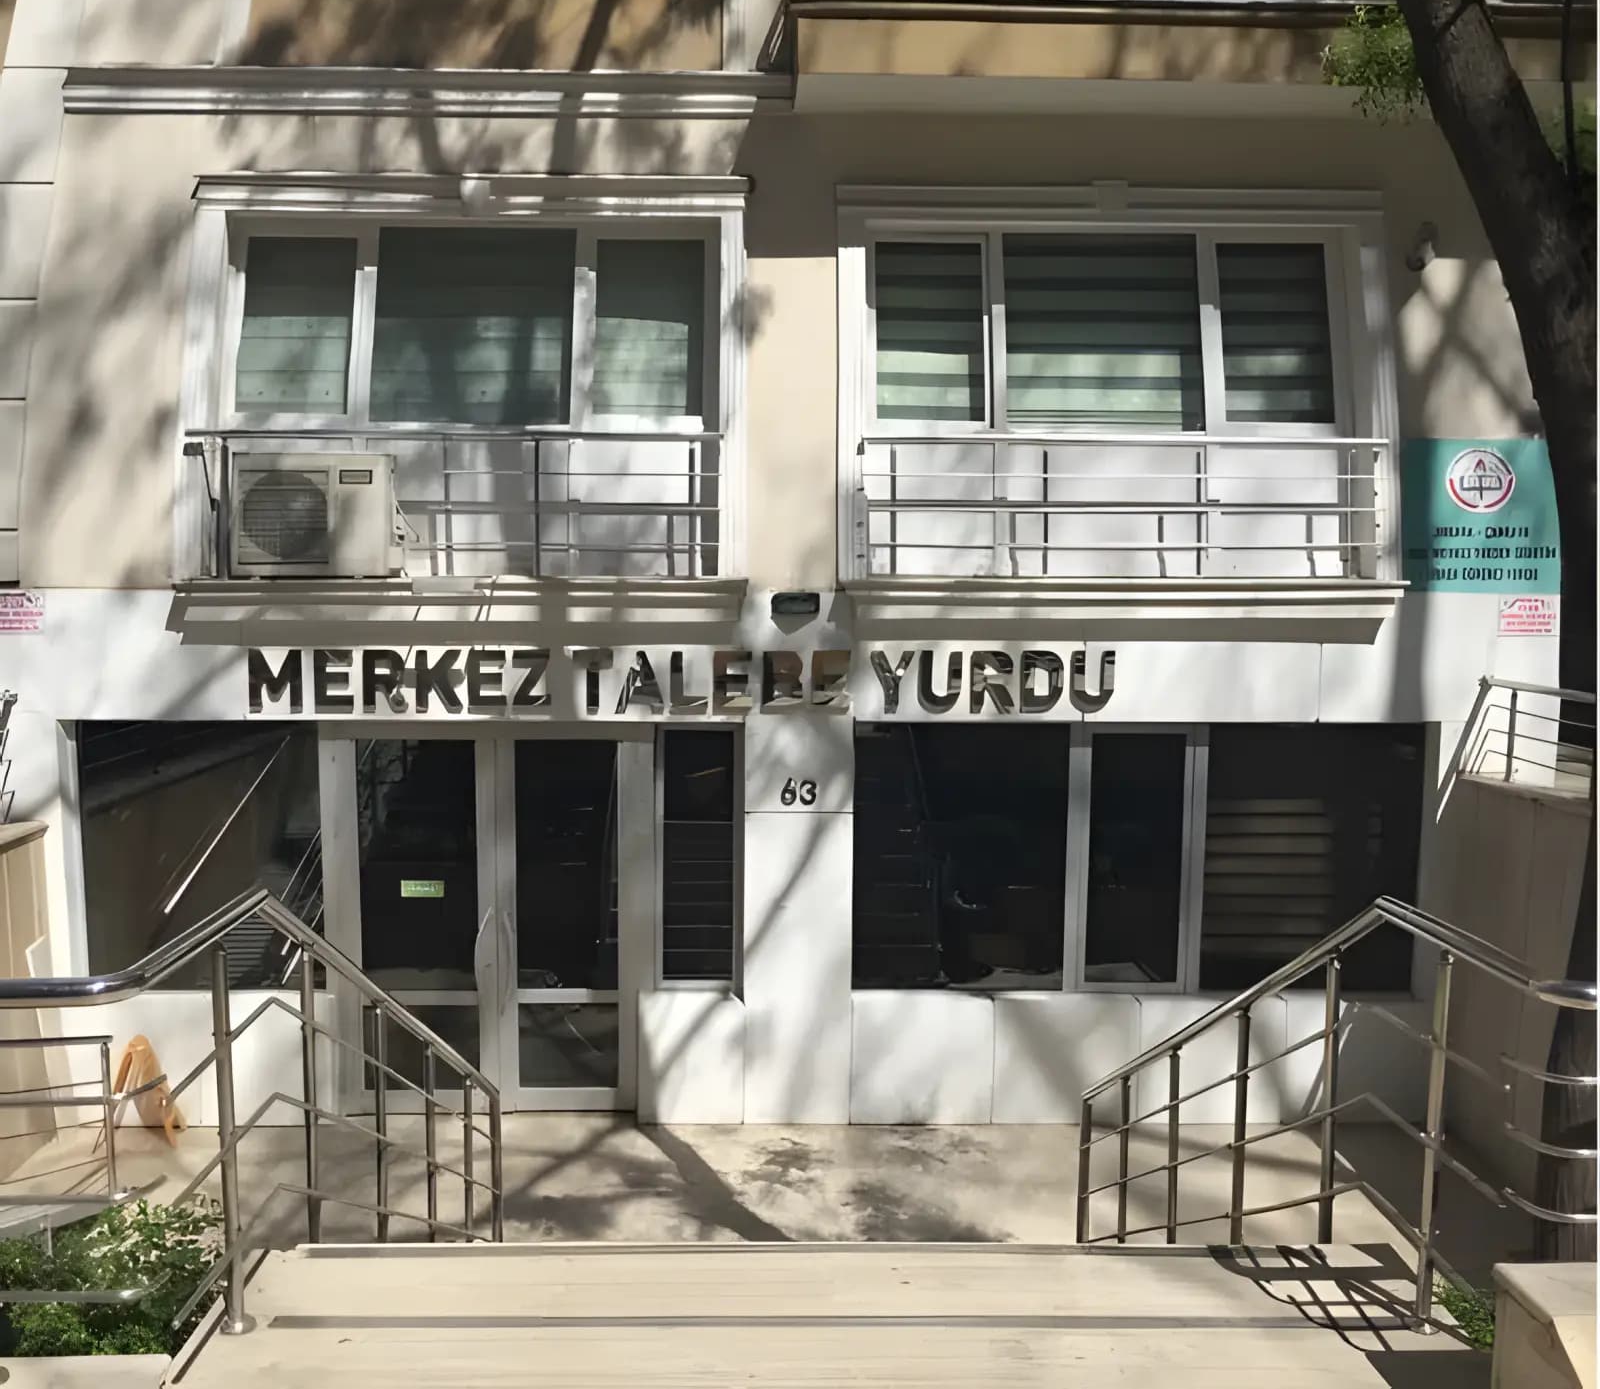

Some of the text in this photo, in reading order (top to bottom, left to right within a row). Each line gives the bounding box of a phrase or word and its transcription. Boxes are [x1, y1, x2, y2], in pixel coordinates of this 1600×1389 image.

[248, 648, 1116, 716] MERKEZ TALEBE YURDU
[780, 777, 817, 806] 63
